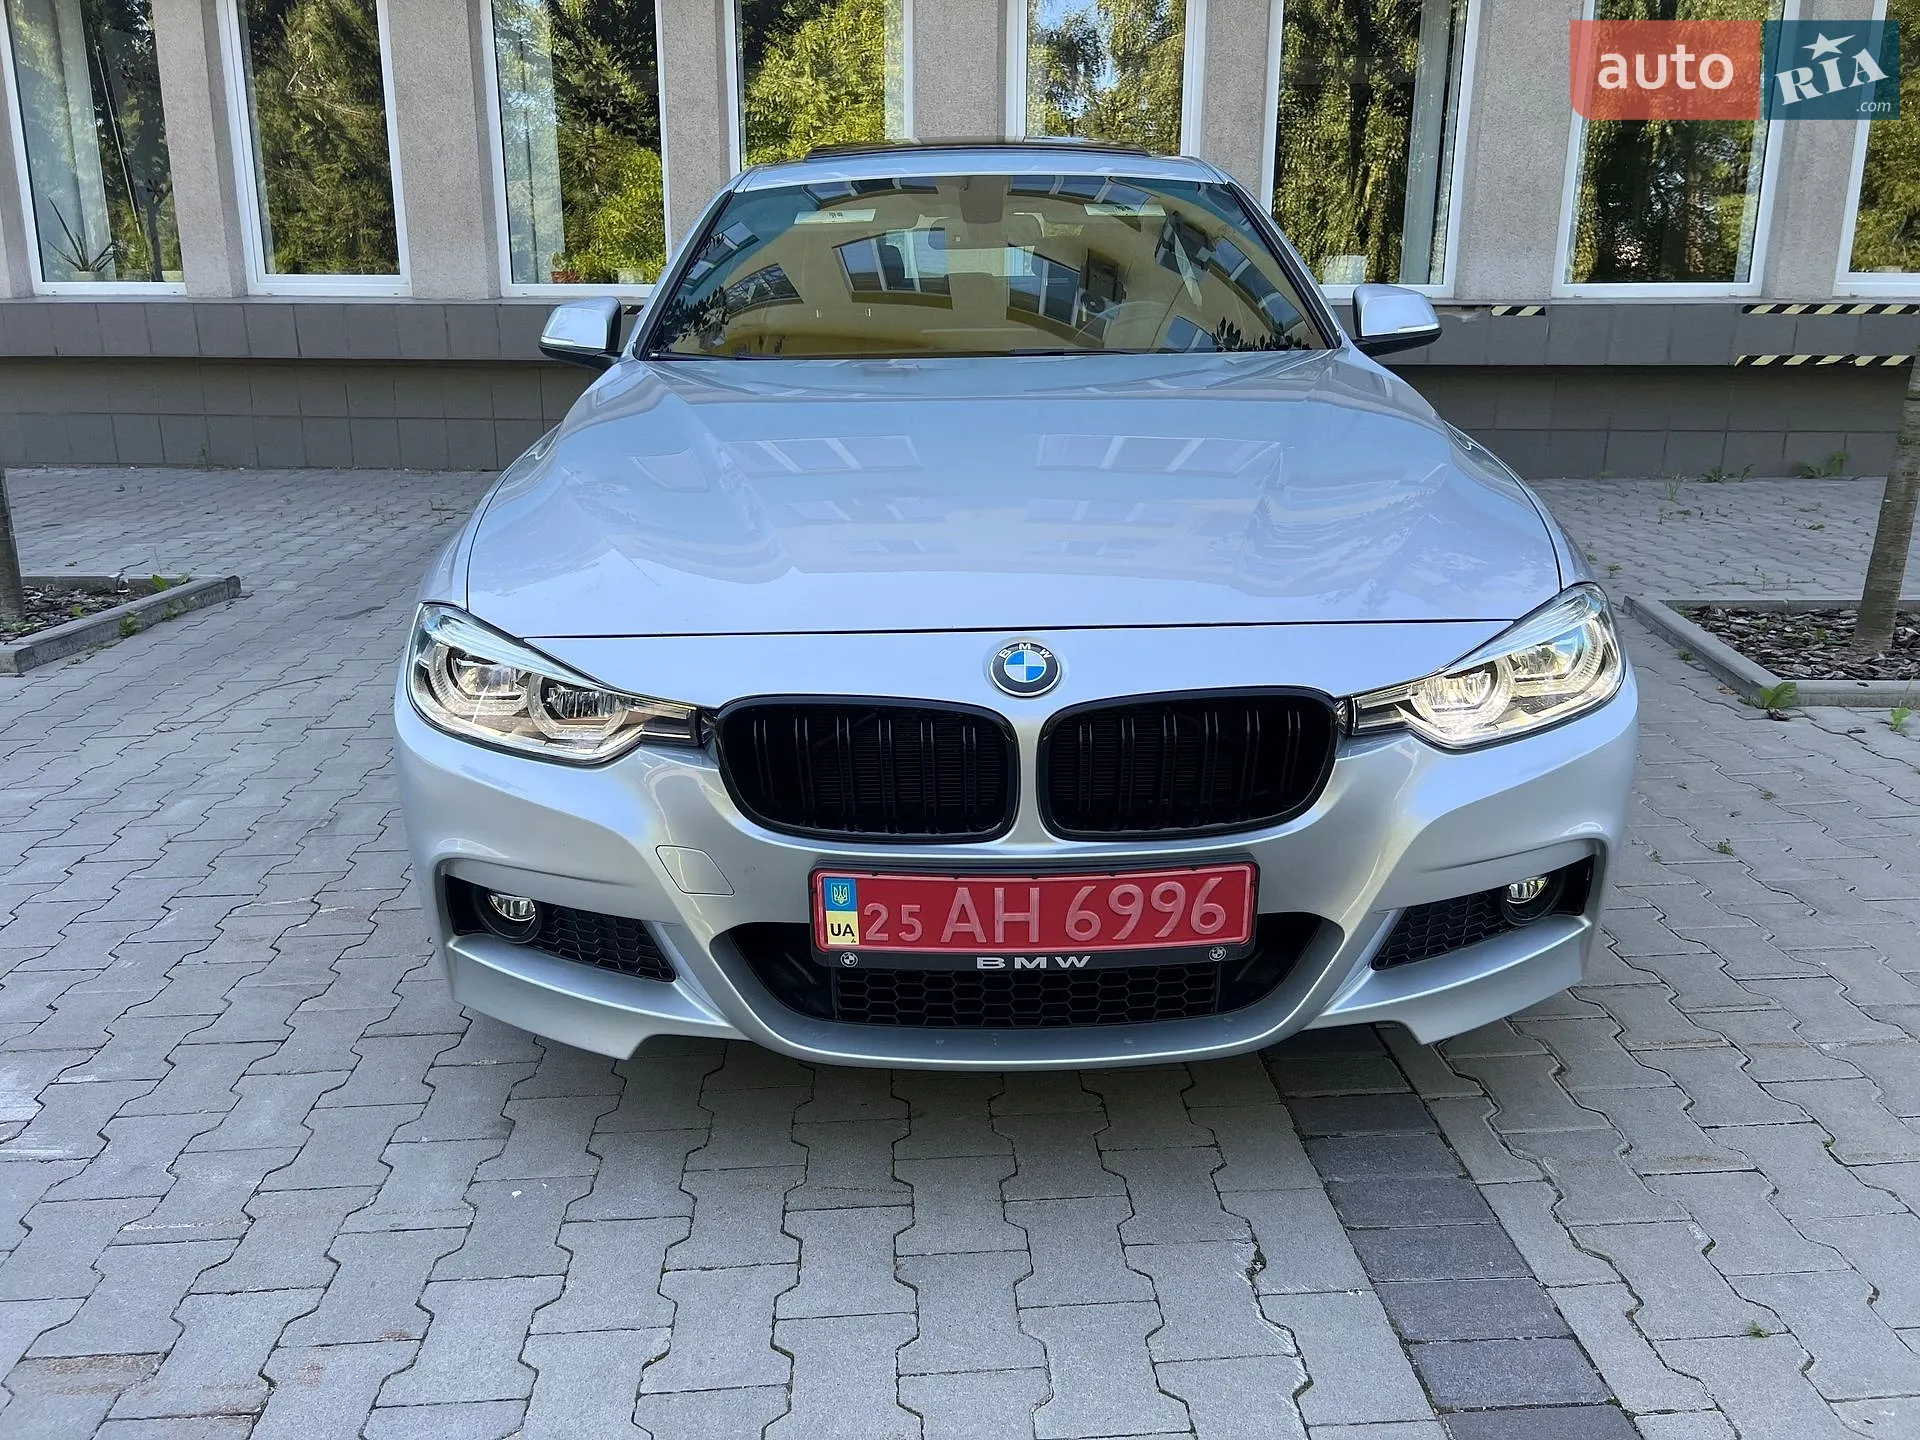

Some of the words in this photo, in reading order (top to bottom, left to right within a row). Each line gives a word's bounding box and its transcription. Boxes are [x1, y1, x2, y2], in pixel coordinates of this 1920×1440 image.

[998, 642, 1053, 659] BMW
[863, 902, 923, 942] 25
[940, 886, 1040, 943] AH
[1064, 876, 1227, 943] 6996
[830, 922, 856, 938] UA
[976, 955, 1092, 969] BMW
